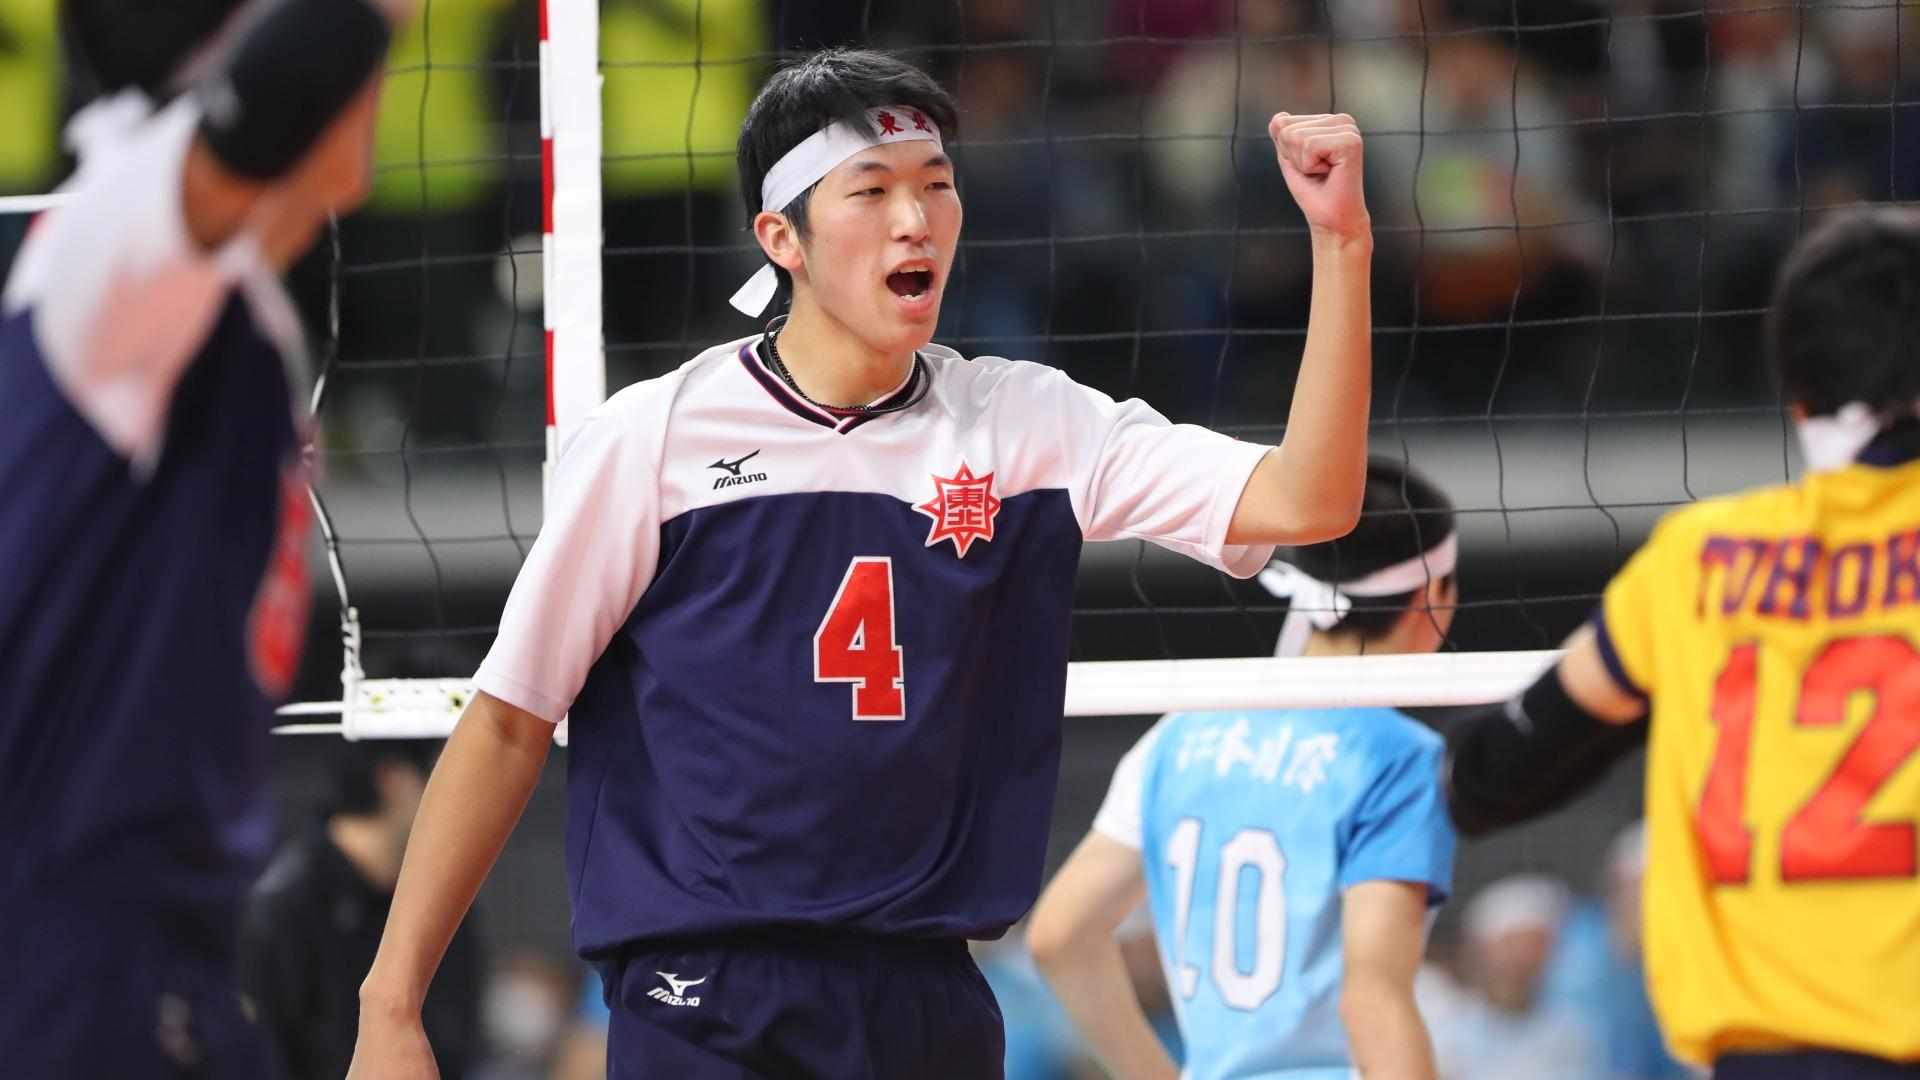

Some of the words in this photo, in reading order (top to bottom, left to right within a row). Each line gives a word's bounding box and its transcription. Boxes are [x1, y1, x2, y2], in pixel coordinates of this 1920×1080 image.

[712, 472, 768, 490] MIZUNO
[813, 556, 906, 720] 4
[1693, 632, 1920, 885] 12
[1166, 816, 1288, 1012] 10
